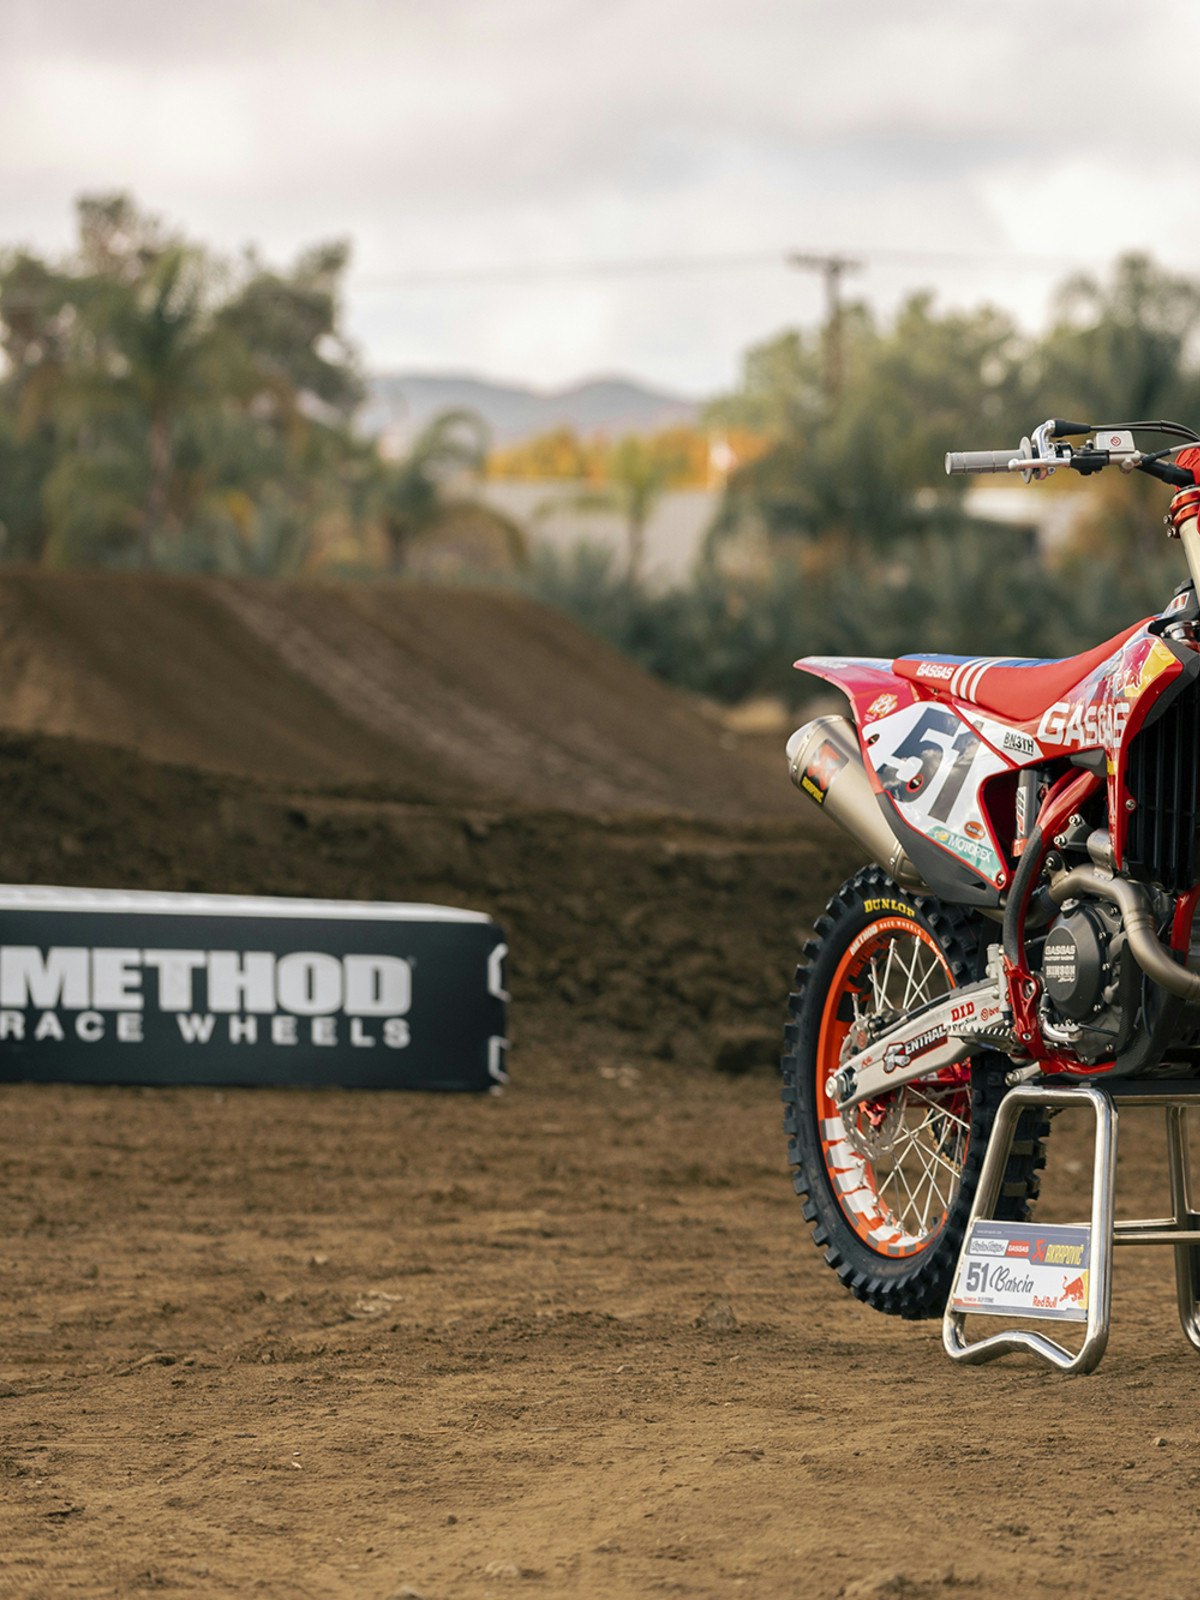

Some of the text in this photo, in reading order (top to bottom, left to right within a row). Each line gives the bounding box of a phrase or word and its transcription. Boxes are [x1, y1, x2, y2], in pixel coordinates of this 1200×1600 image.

[916, 662, 955, 680] GASGAS
[1037, 702, 1131, 748] GASGAS
[1003, 731, 1035, 752] BN3TH
[876, 707, 984, 823] 51
[864, 898, 915, 917] DUNLOP
[1044, 945, 1076, 955] GASGAS
[0, 945, 412, 1016] METHOD
[951, 1002, 975, 1021] DID
[0, 1010, 411, 1049] RACE WHEELS
[966, 1262, 1034, 1294] 51 Barcia
[1032, 1295, 1058, 1309] Red Bull
